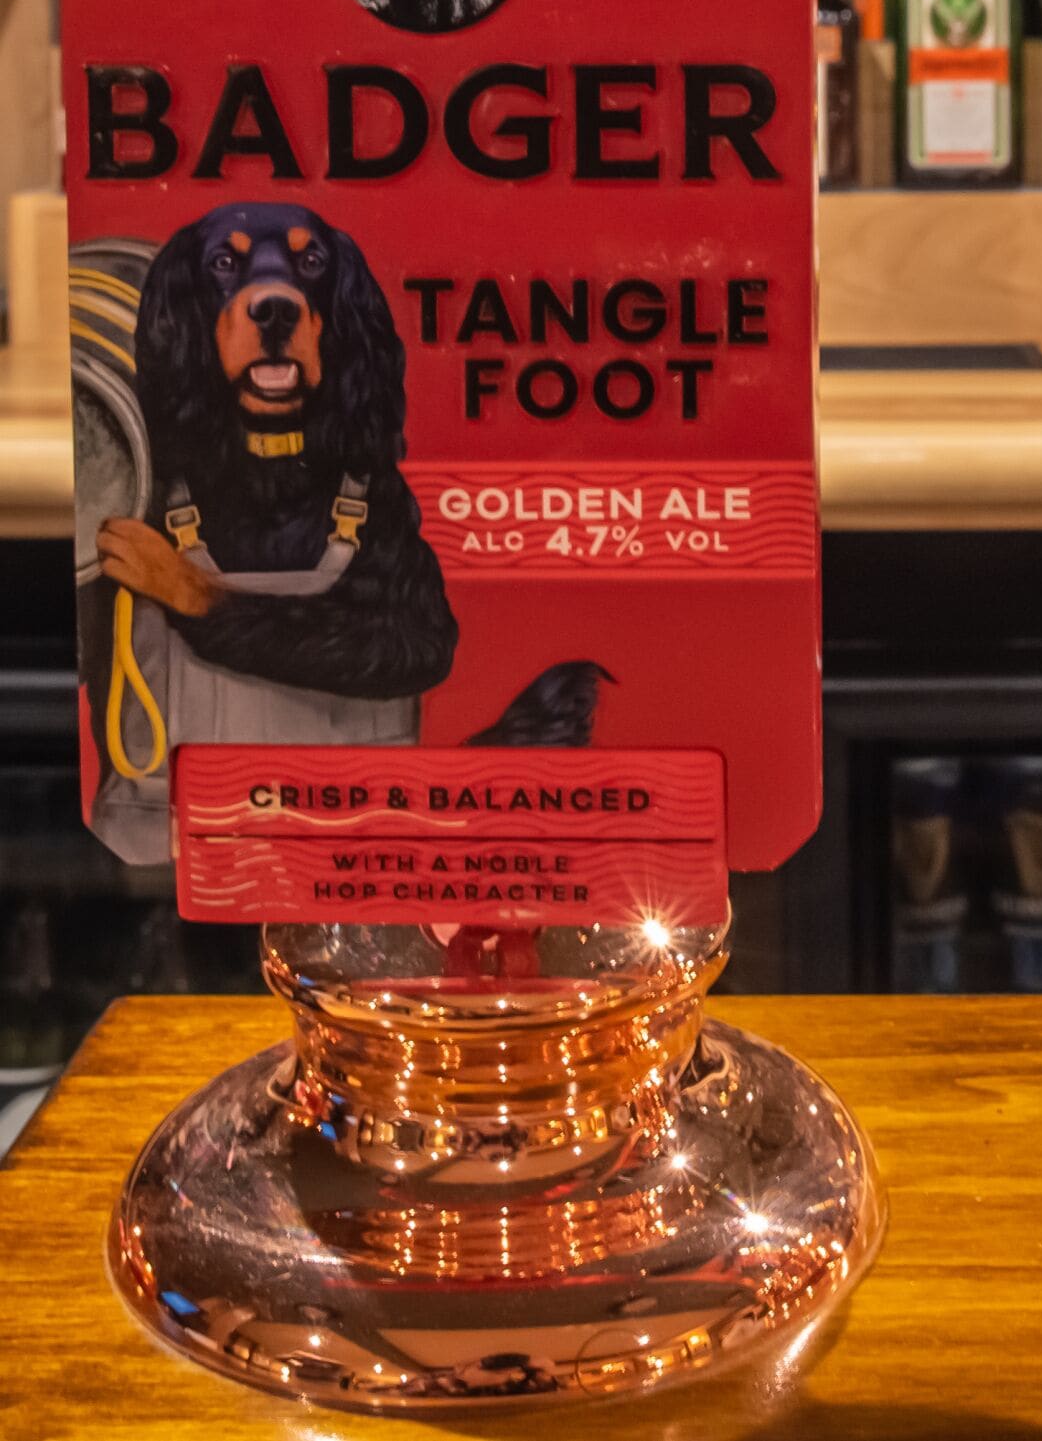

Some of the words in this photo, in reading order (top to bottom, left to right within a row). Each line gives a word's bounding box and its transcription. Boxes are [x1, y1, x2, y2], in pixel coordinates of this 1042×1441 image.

[85, 62, 784, 181] BADGER
[403, 278, 769, 345] TANGLE
[465, 358, 714, 420] FOOT
[438, 487, 643, 521] GOLDEN
[659, 487, 752, 521] ALE
[462, 531, 525, 553] ALC
[546, 525, 645, 558] 4.7%
[665, 531, 730, 553] VOL
[248, 784, 369, 810] CRISP
[387, 787, 409, 810] &
[428, 786, 652, 813] BALANCED
[332, 853, 415, 873] WITH
[431, 854, 449, 873] A
[463, 853, 570, 874] NOBLE
[314, 881, 378, 901] HOP
[393, 882, 590, 903] CHARACTER
